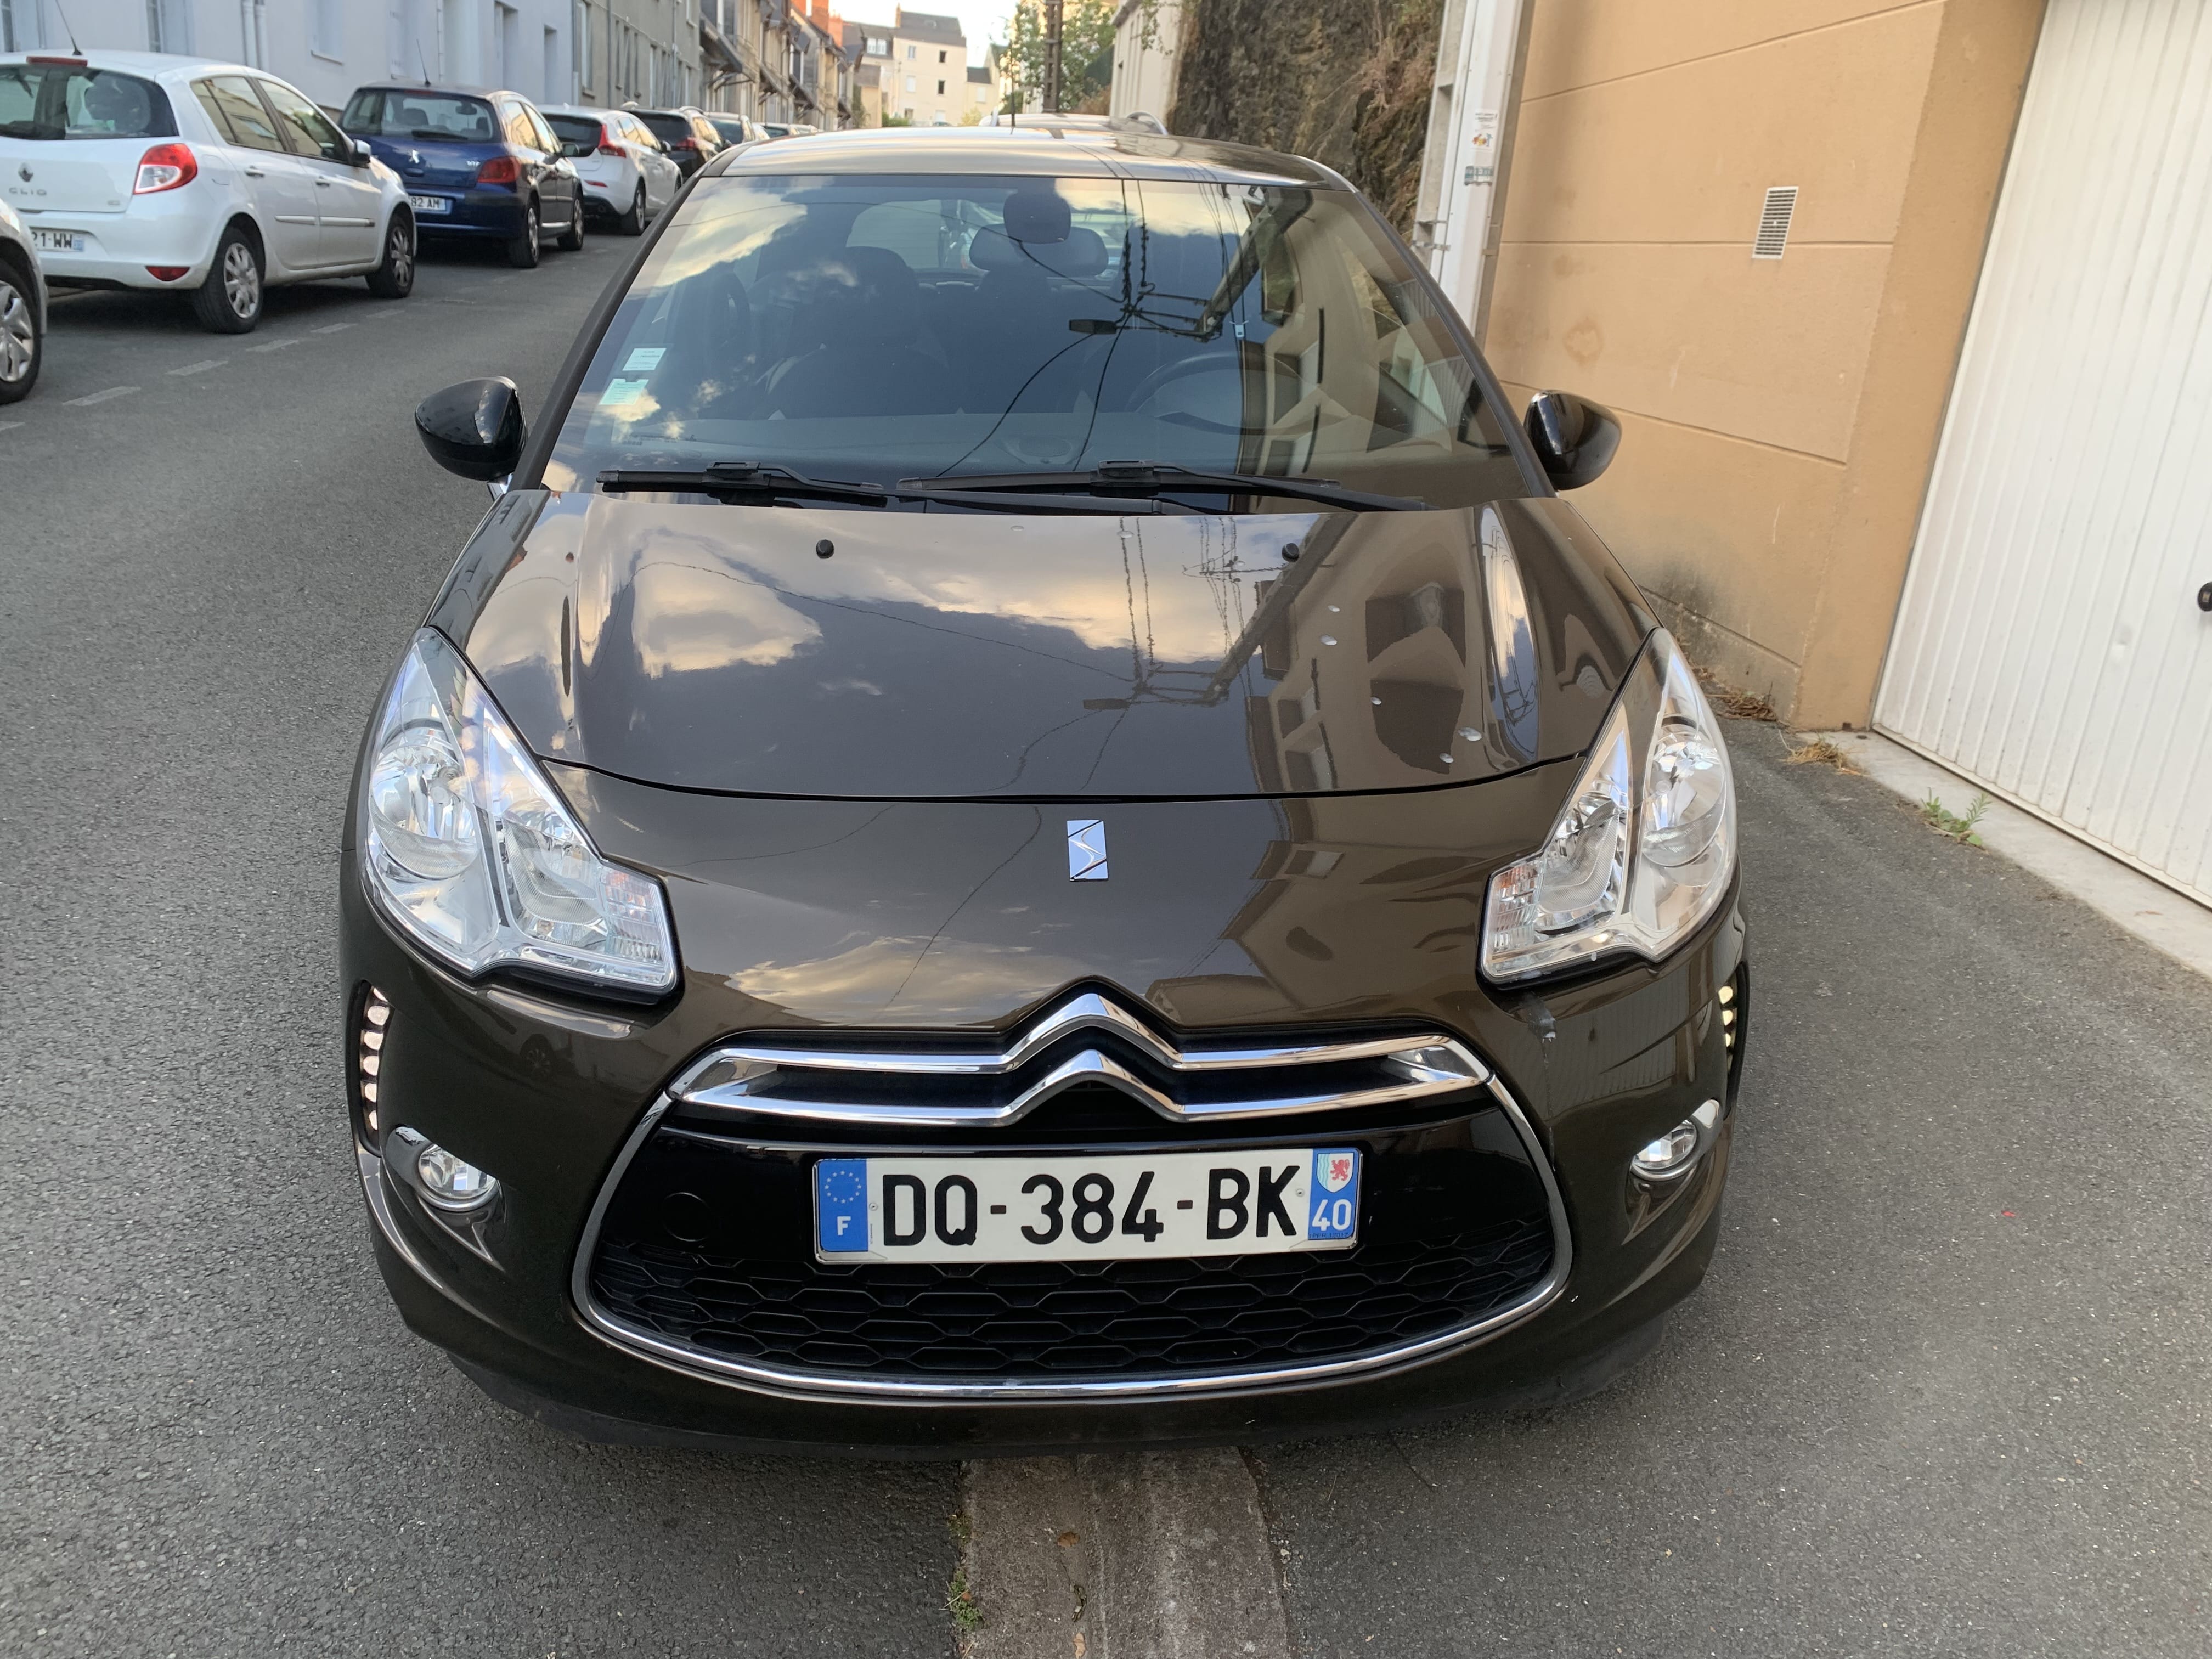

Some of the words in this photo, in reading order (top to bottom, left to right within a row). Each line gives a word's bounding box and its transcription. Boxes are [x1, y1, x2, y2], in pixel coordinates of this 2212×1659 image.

[9, 187, 47, 195] CLIO
[1312, 1199, 1352, 1231] 40
[837, 1216, 851, 1235] F
